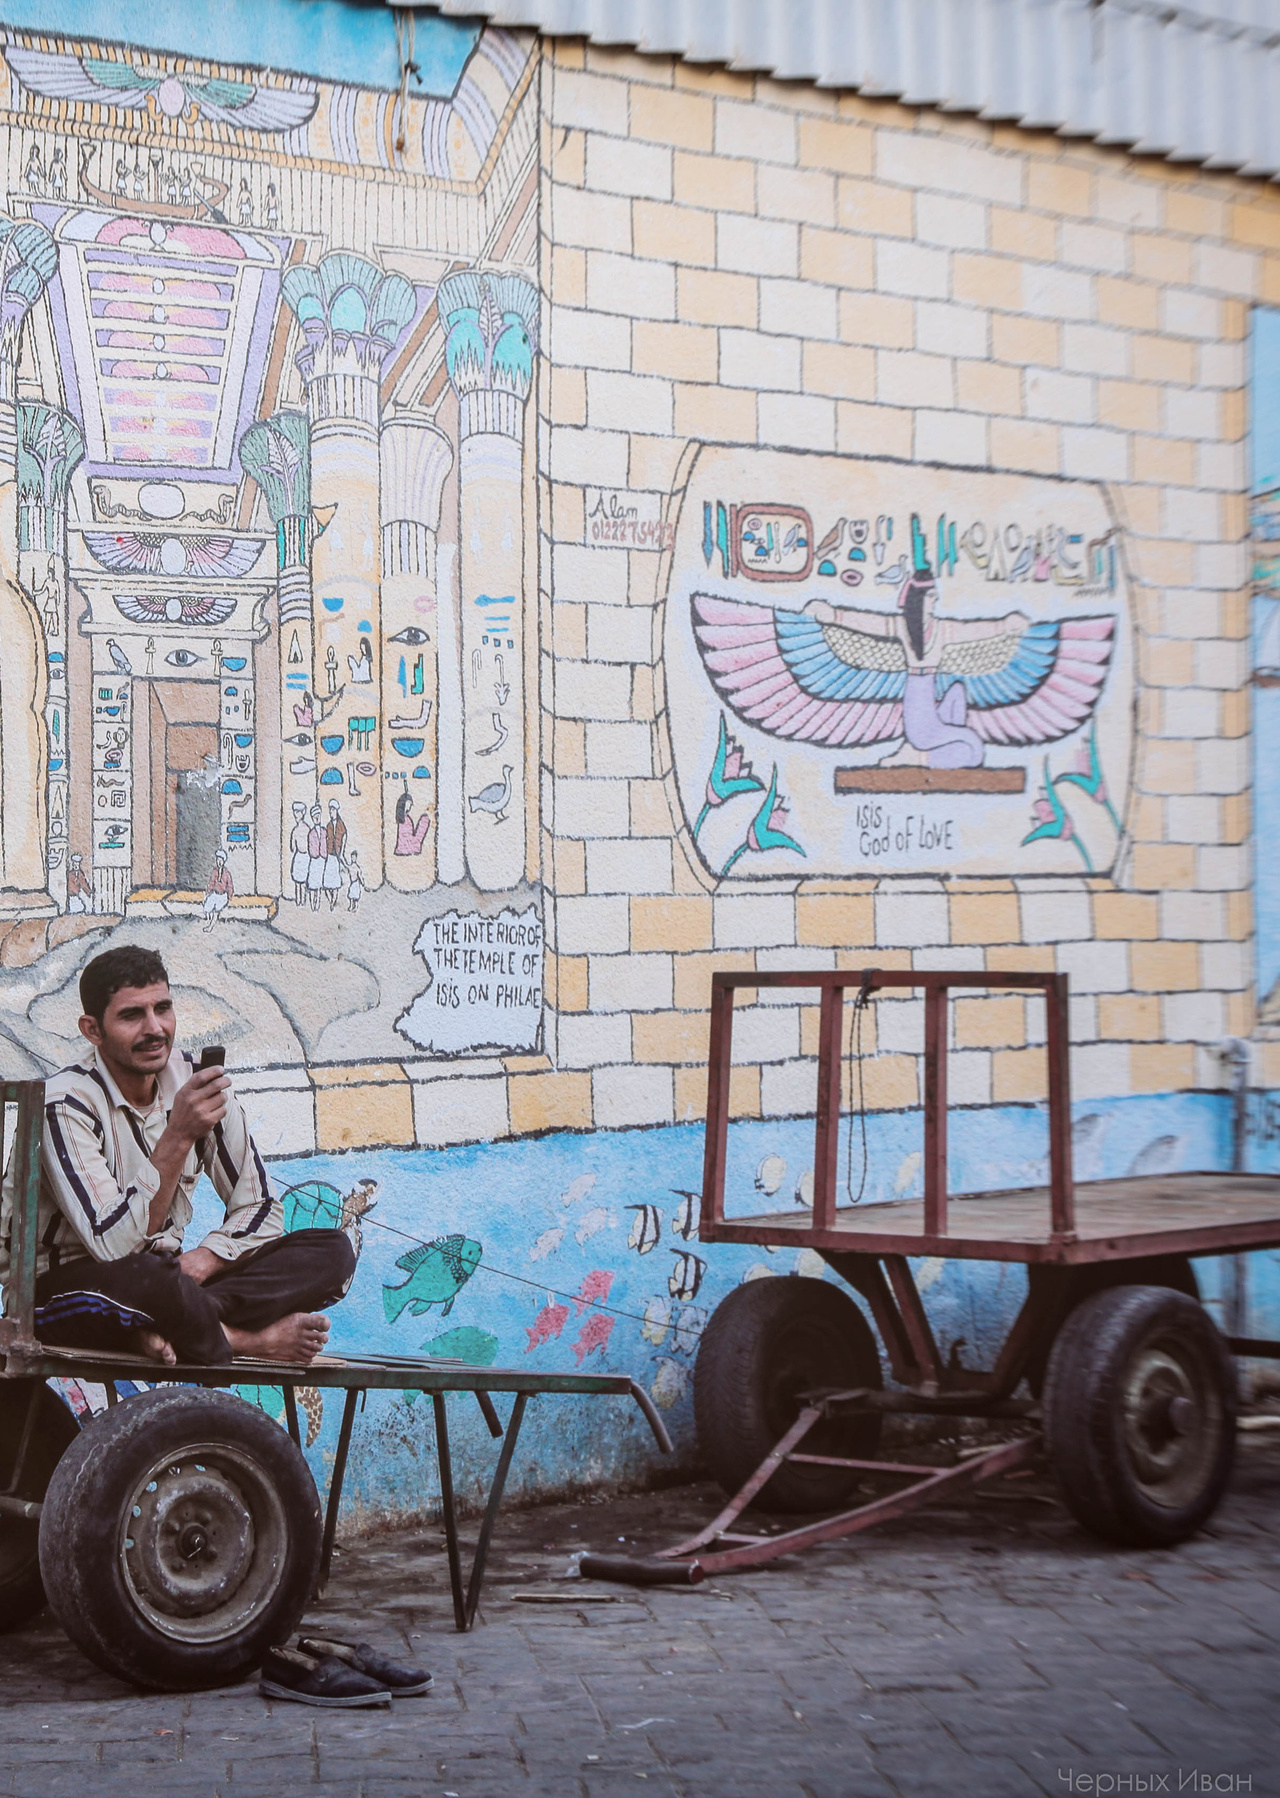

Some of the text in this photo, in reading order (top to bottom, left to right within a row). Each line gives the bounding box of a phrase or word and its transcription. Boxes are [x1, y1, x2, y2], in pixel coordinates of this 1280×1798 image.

[588, 491, 638, 520] Alam
[860, 816, 891, 857] God
[433, 922, 541, 948] THE INTERIOR OF
[433, 948, 540, 977] THE TEMPLE OF
[467, 983, 489, 1005] ON
[496, 983, 541, 1009] PHILAE
